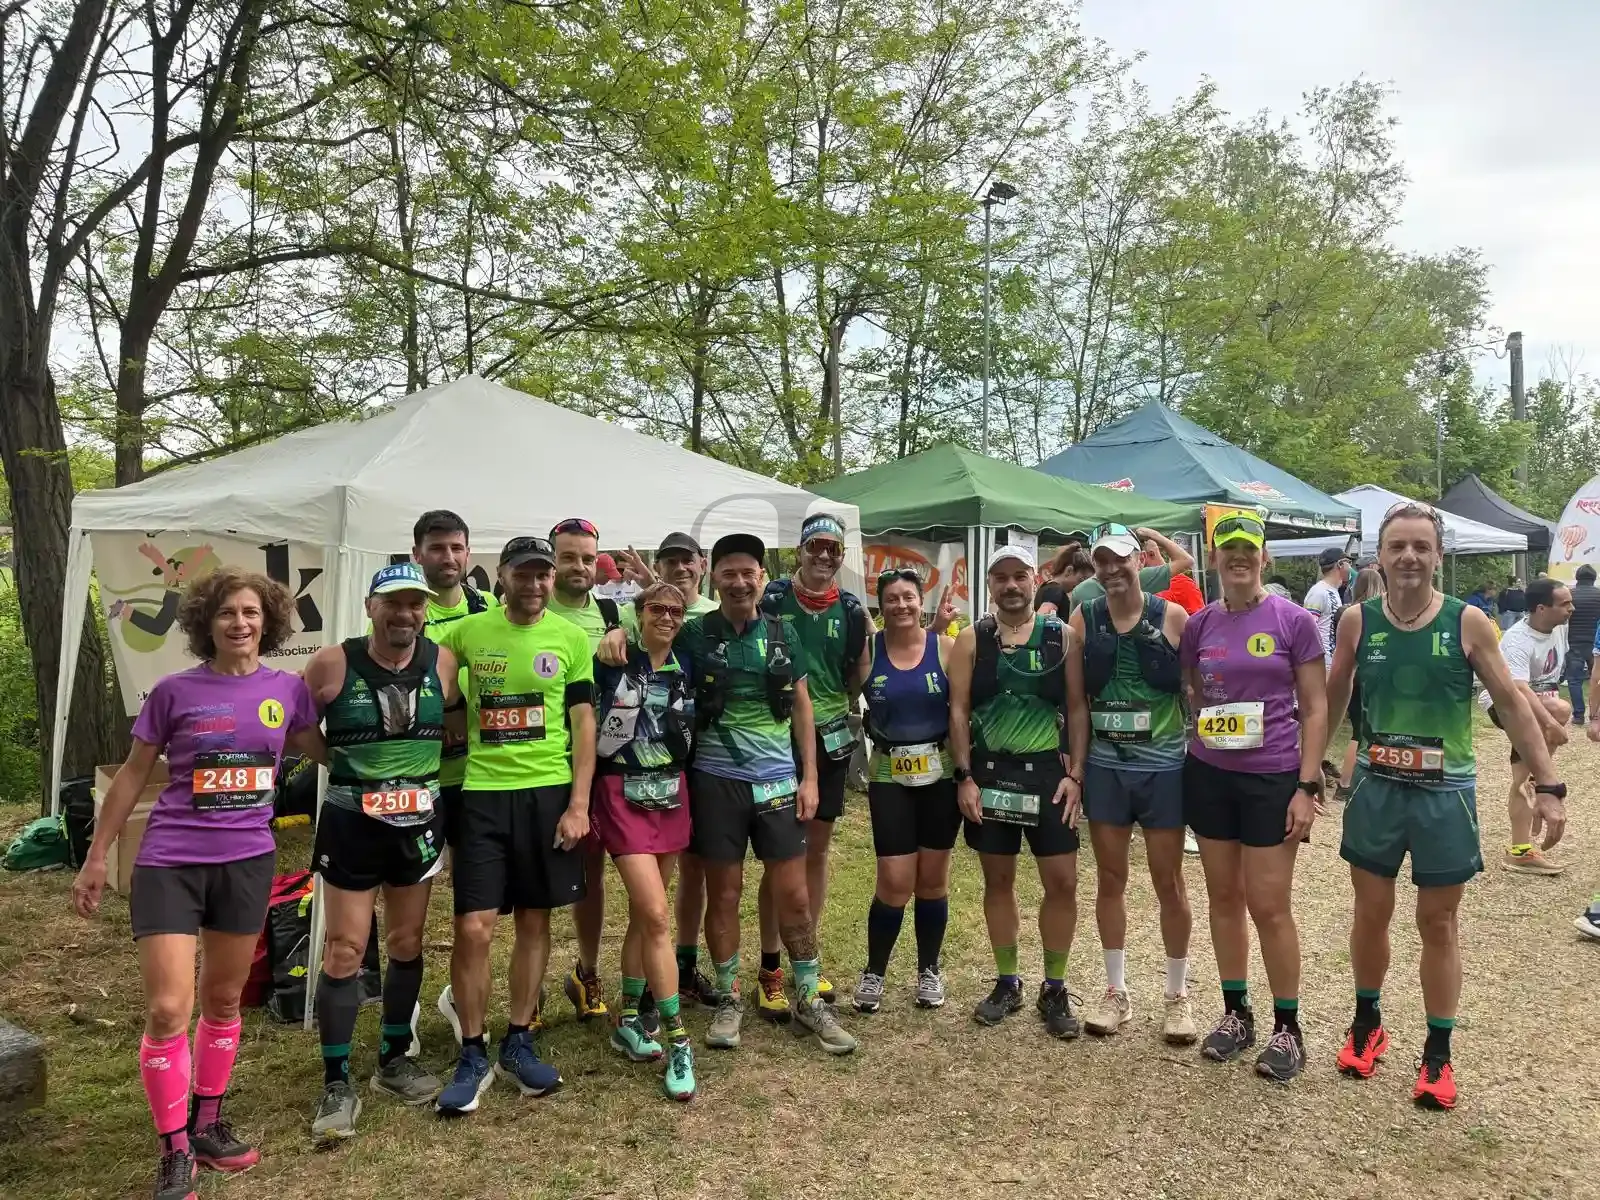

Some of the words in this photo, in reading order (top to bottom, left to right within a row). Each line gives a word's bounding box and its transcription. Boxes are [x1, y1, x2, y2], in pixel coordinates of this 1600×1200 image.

[485, 708, 521, 727] 256
[1101, 713, 1122, 729] 78
[1204, 716, 1239, 733] 420
[895, 757, 921, 772] 401
[1376, 747, 1414, 766] 259
[202, 769, 248, 789] 248
[371, 791, 409, 812] 250
[991, 790, 1012, 807] 76
